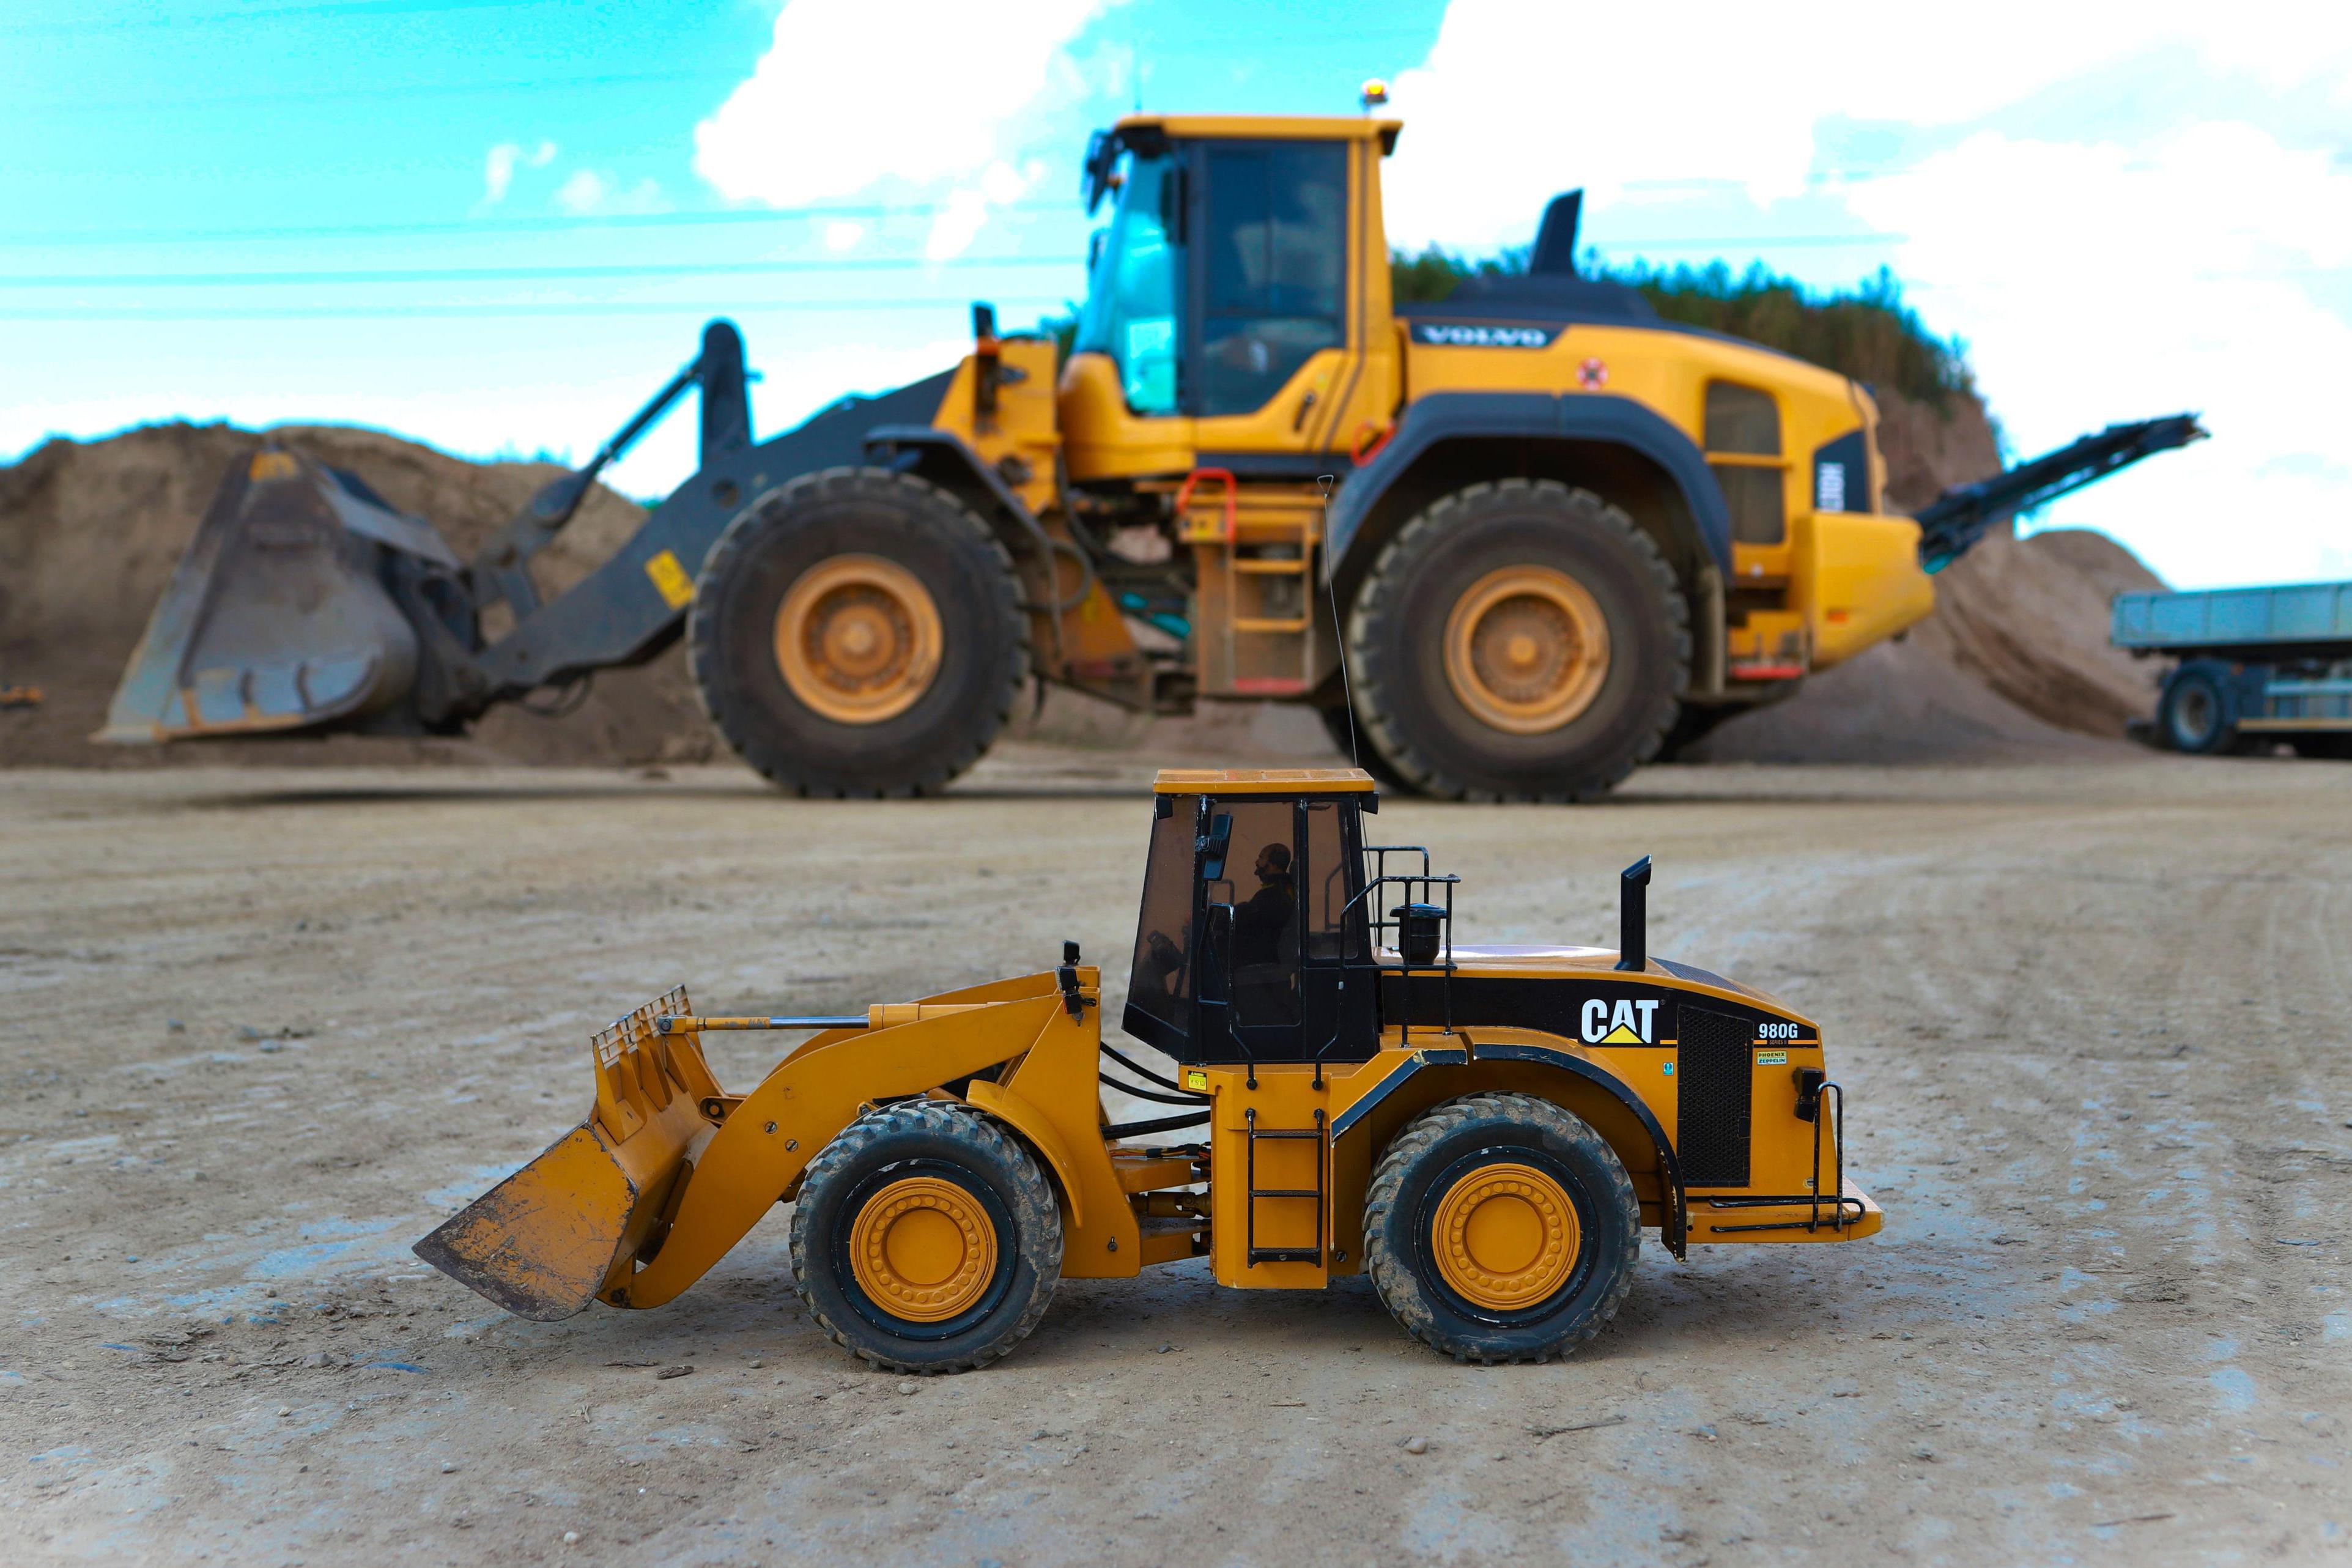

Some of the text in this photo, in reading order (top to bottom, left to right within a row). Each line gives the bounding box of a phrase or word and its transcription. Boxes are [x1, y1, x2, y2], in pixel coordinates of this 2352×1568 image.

[1424, 325, 1547, 348] VOLVO
[1581, 999, 1659, 1043] CAT
[1759, 1023, 1798, 1038] 980G
